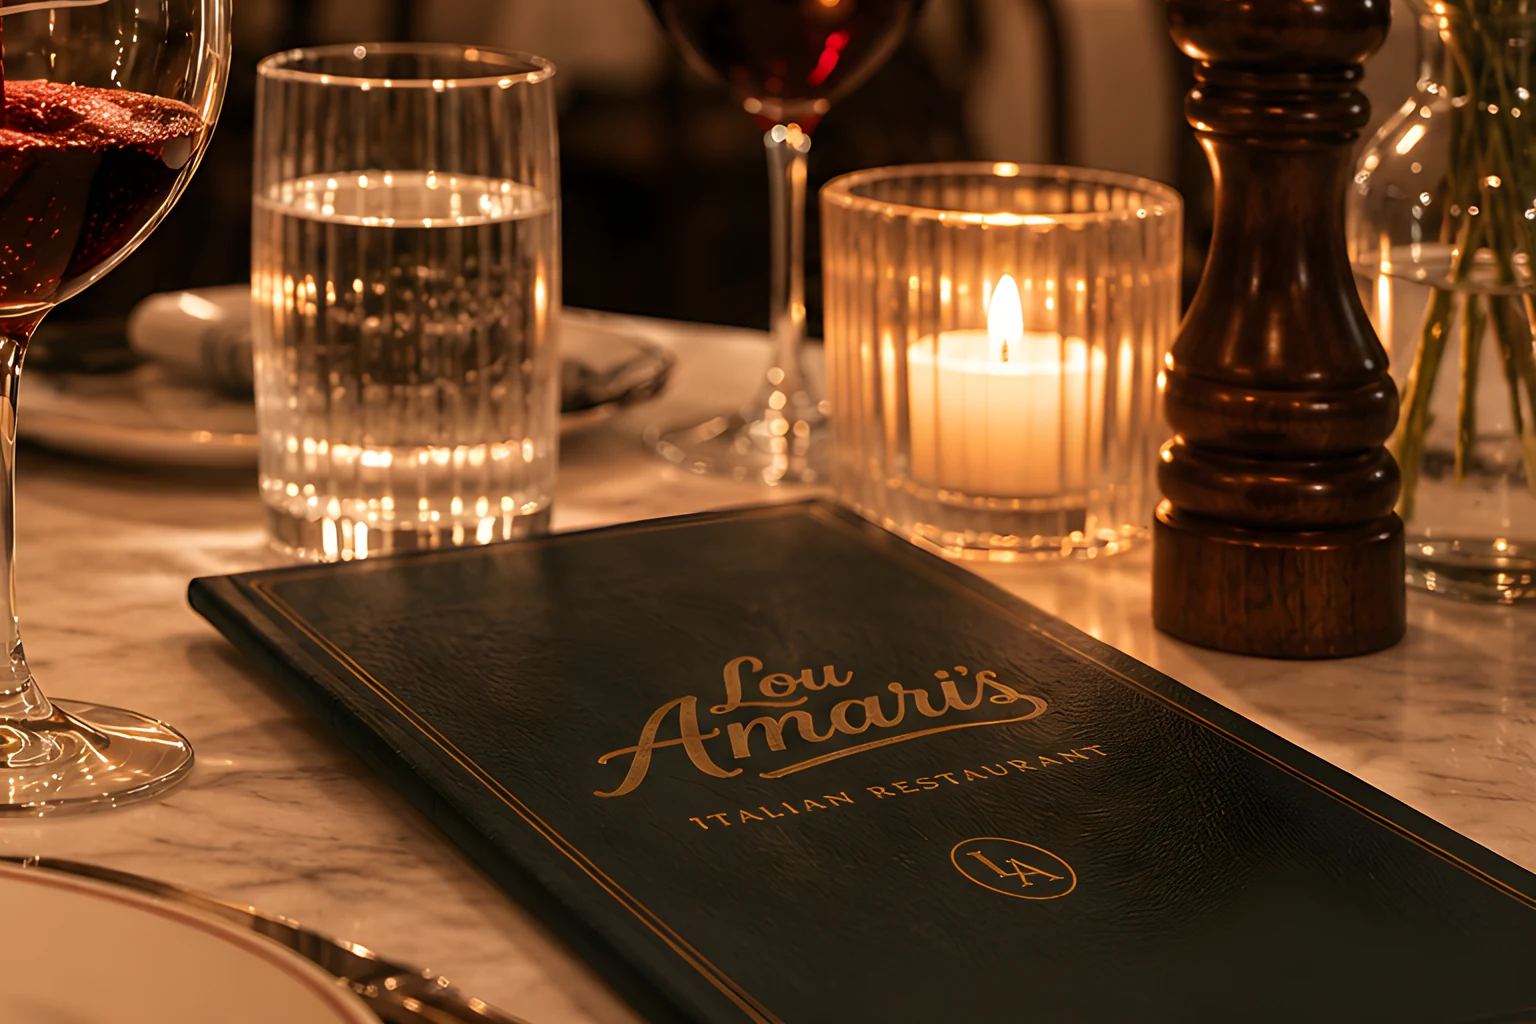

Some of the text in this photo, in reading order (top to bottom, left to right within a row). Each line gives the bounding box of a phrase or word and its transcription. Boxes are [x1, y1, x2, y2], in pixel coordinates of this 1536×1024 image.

[709, 655, 854, 714] Lou
[592, 664, 1049, 798] Amari's
[687, 743, 1110, 831] ITALIAN RESTAURANT
[965, 850, 1065, 888] LA
